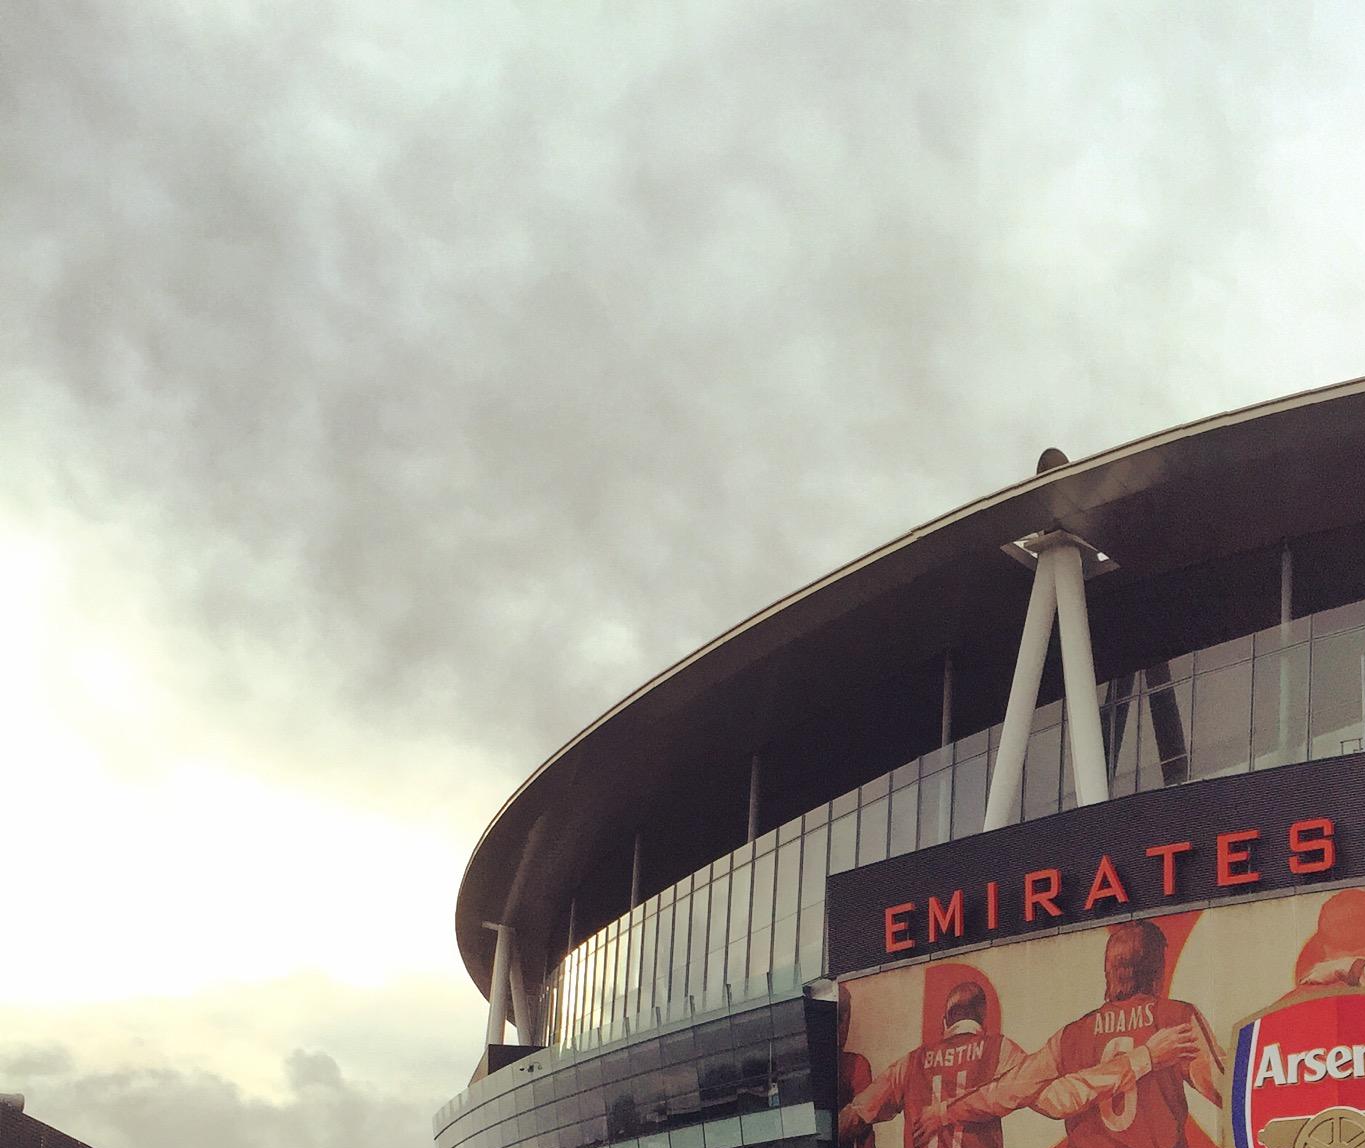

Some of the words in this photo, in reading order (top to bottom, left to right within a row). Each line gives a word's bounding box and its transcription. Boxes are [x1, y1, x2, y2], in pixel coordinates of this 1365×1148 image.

[884, 817, 1336, 953] EMIRATES
[1094, 1002, 1155, 1035] ADAMS
[924, 1040, 984, 1069] BASTIN
